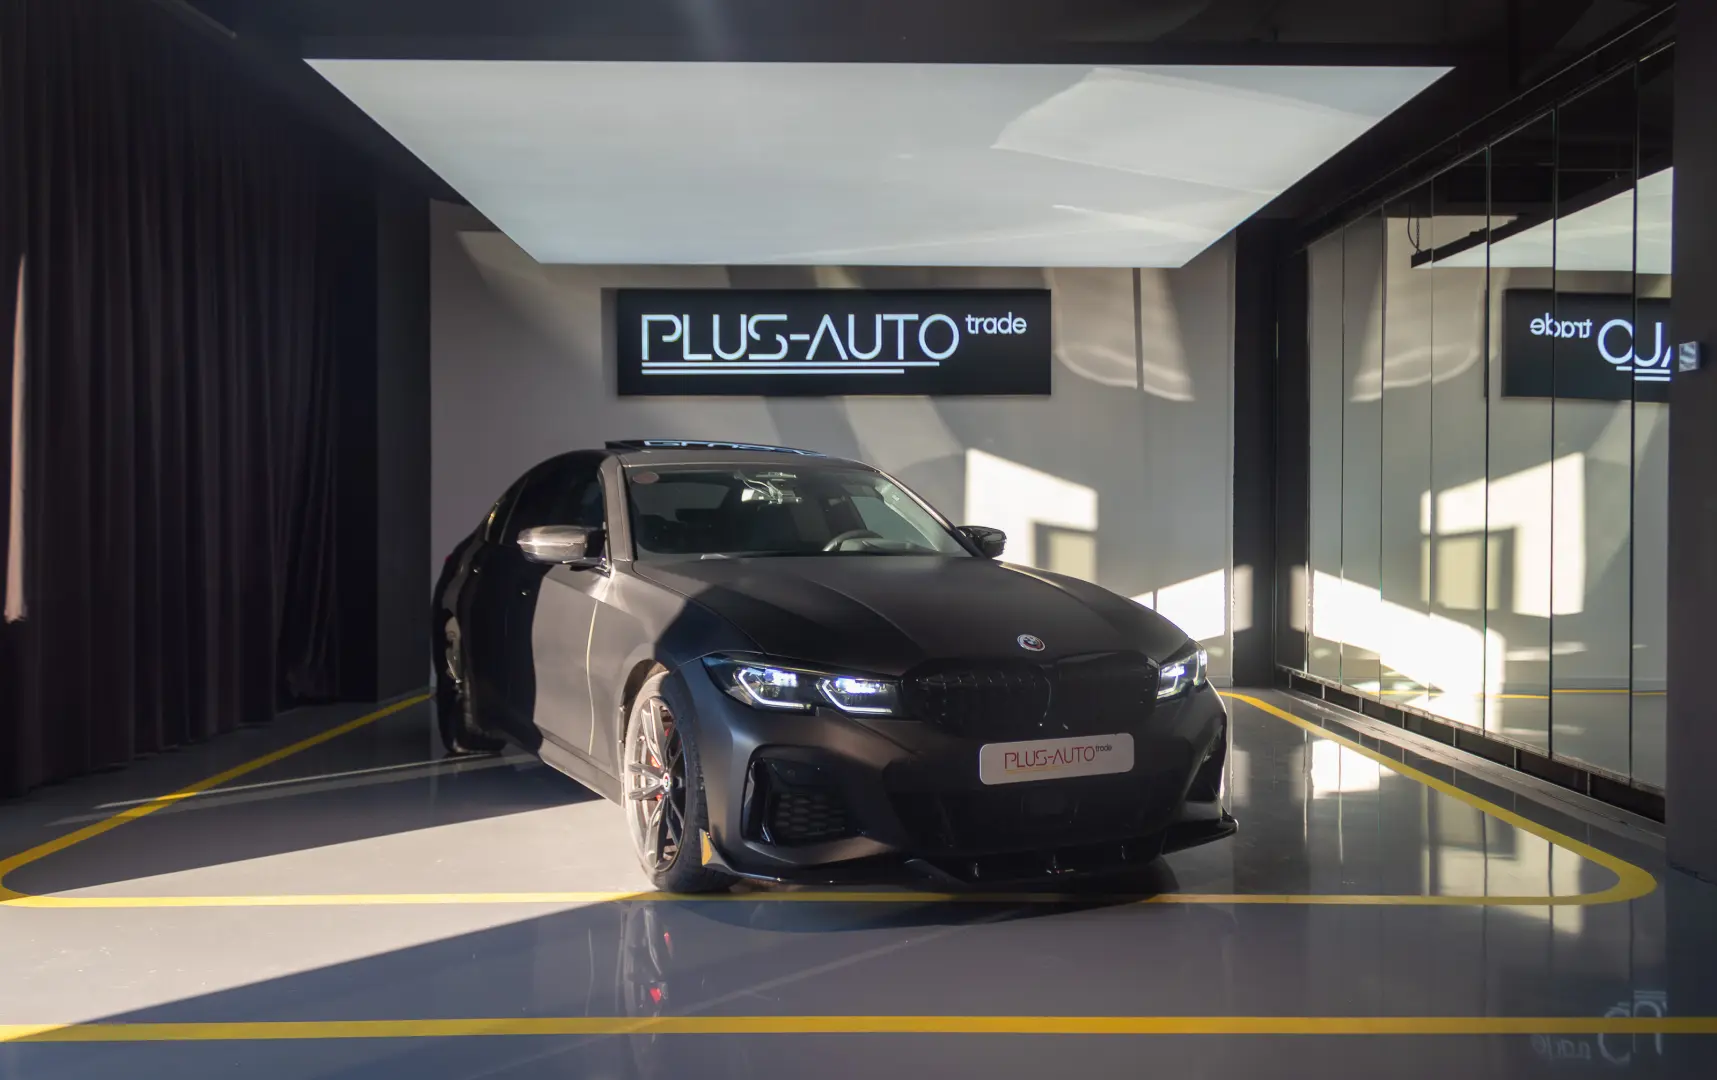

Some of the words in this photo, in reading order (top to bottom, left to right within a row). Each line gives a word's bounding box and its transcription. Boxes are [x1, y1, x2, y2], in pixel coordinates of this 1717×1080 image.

[641, 313, 960, 361] PLUS-AUTO
[965, 311, 1027, 335] trade
[1004, 746, 1096, 769] PLUS-AUTO
[1095, 743, 1112, 752] trade
